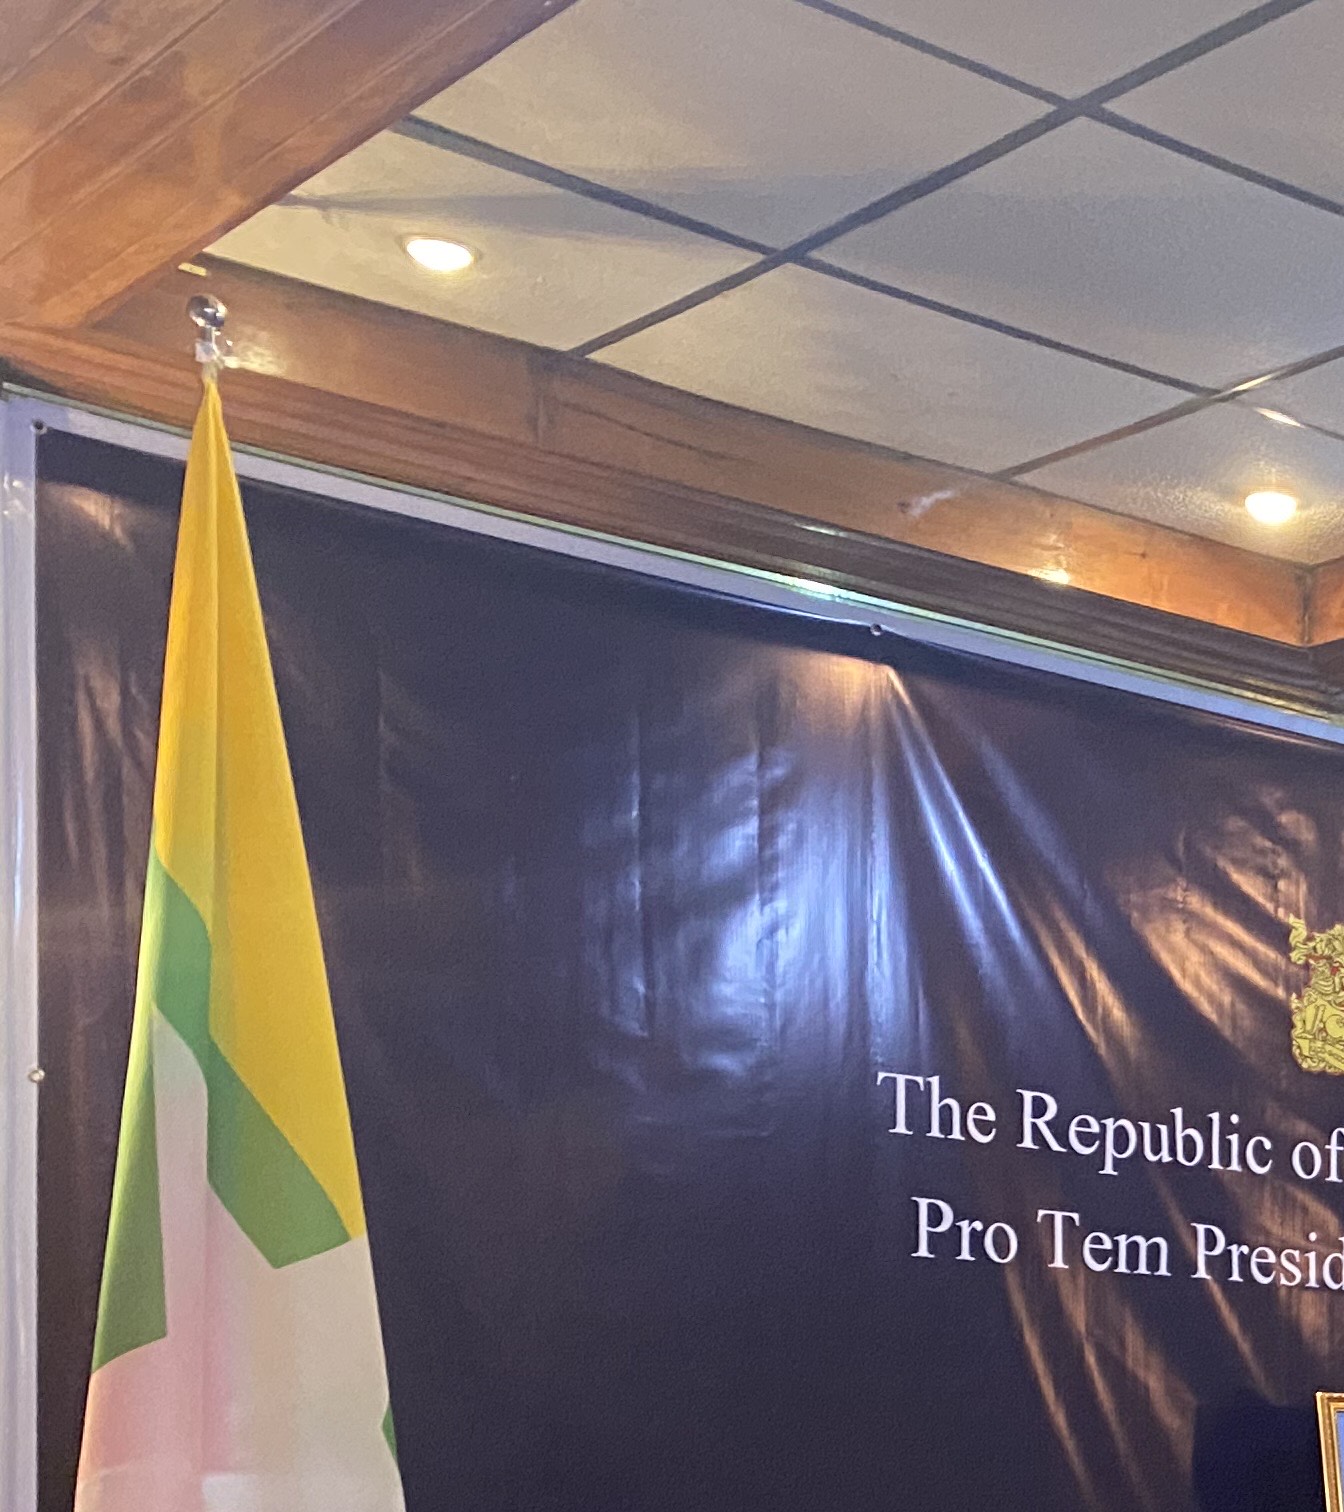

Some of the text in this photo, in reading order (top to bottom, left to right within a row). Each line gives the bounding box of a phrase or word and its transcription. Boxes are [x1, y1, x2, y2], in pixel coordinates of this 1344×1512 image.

[876, 1071, 997, 1144] The
[1015, 1088, 1273, 1176] Republic
[910, 1196, 1018, 1264] Pro
[1036, 1208, 1172, 1277] Tem
